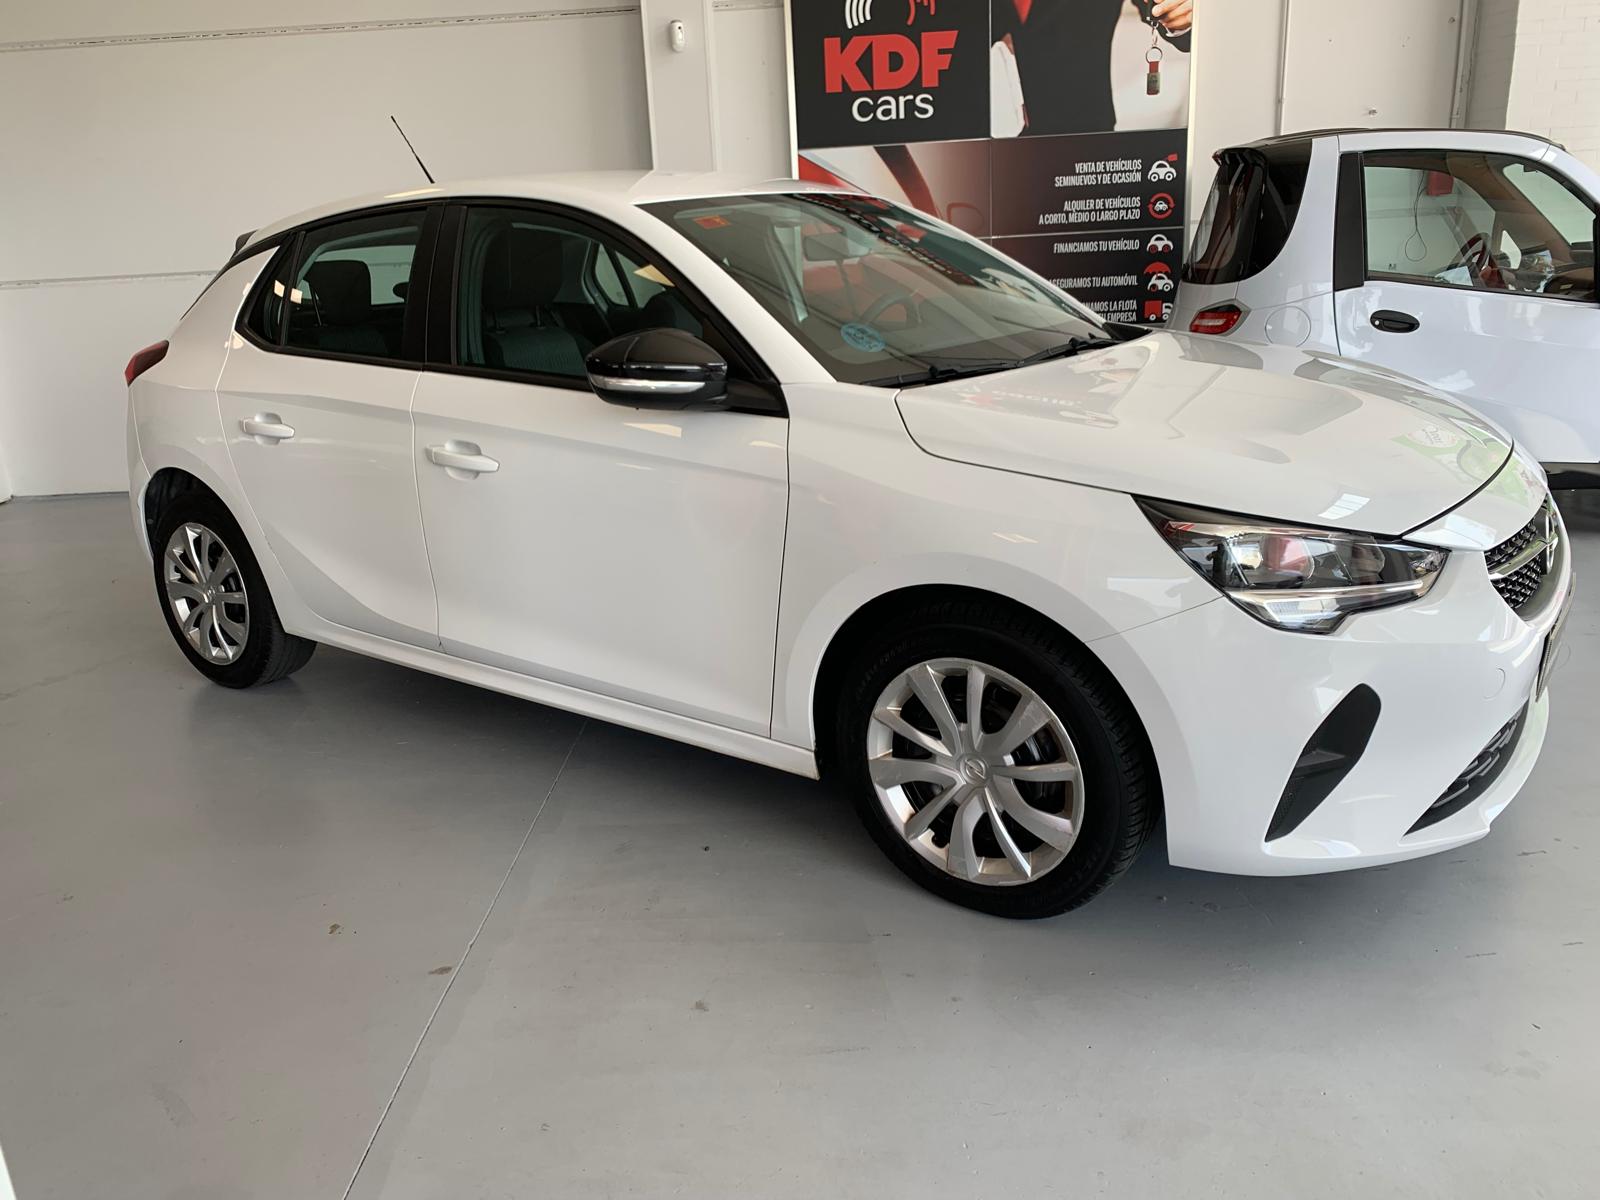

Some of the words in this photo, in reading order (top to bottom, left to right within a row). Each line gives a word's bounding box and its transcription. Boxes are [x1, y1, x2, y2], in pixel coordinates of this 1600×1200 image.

[824, 30, 959, 93] KDF
[852, 93, 934, 122] cars
[1075, 161, 1096, 174] VENTA
[1096, 161, 1105, 173] DE
[1105, 158, 1142, 172] VEHÍCULOS
[1054, 174, 1097, 187] SEMINUEVOS
[1097, 174, 1103, 185] Y
[1102, 173, 1111, 184] DE
[1112, 169, 1142, 183] OCASIÓN
[1063, 198, 1095, 212] ALQUILER
[1095, 198, 1105, 210] DE
[1104, 195, 1141, 209] VEHÍCULOS
[1038, 213, 1045, 225] A
[1044, 212, 1068, 225] CORTO,
[1068, 211, 1089, 223] MEDIO
[1090, 210, 1096, 221] O
[1096, 209, 1119, 222] LARGO
[1119, 208, 1141, 220] PLAZO
[1053, 241, 1099, 254] FINANCIAMOS
[1098, 240, 1108, 251] TU
[1108, 237, 1140, 251] VEHÍCULO
[1092, 276, 1101, 288] TU
[1101, 273, 1138, 287] AUTOMÓVIL
[1109, 300, 1118, 311] LA
[1118, 299, 1138, 311] FLOTA
[1107, 311, 1137, 322] EMPRESA
